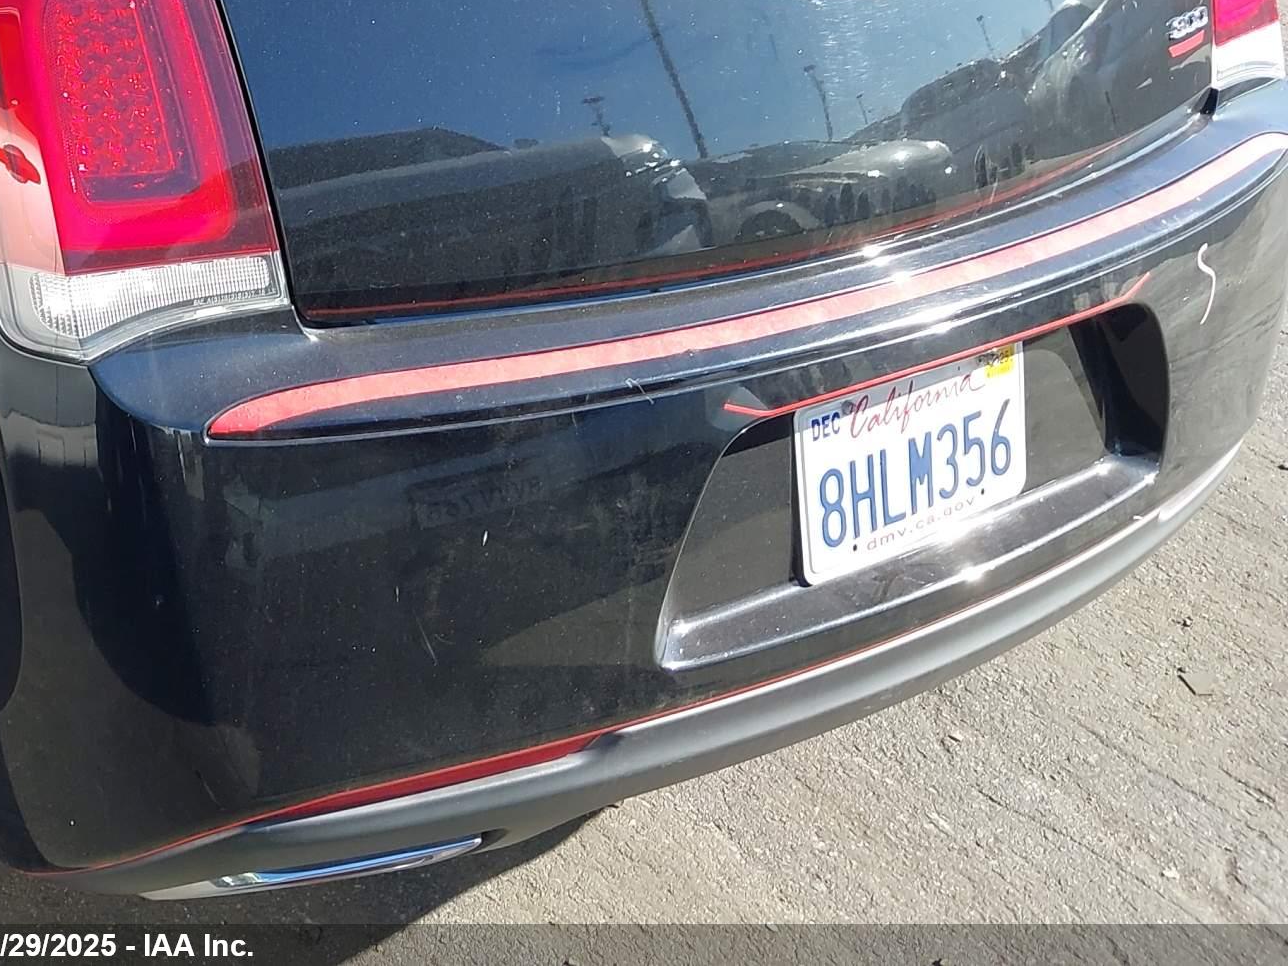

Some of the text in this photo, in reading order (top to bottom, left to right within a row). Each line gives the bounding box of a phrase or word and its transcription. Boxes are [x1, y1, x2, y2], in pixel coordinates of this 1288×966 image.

[811, 411, 841, 441] DEC
[850, 373, 986, 438] California
[819, 398, 1011, 548] 8HLM356
[867, 496, 975, 551] dmv.ca.gov
